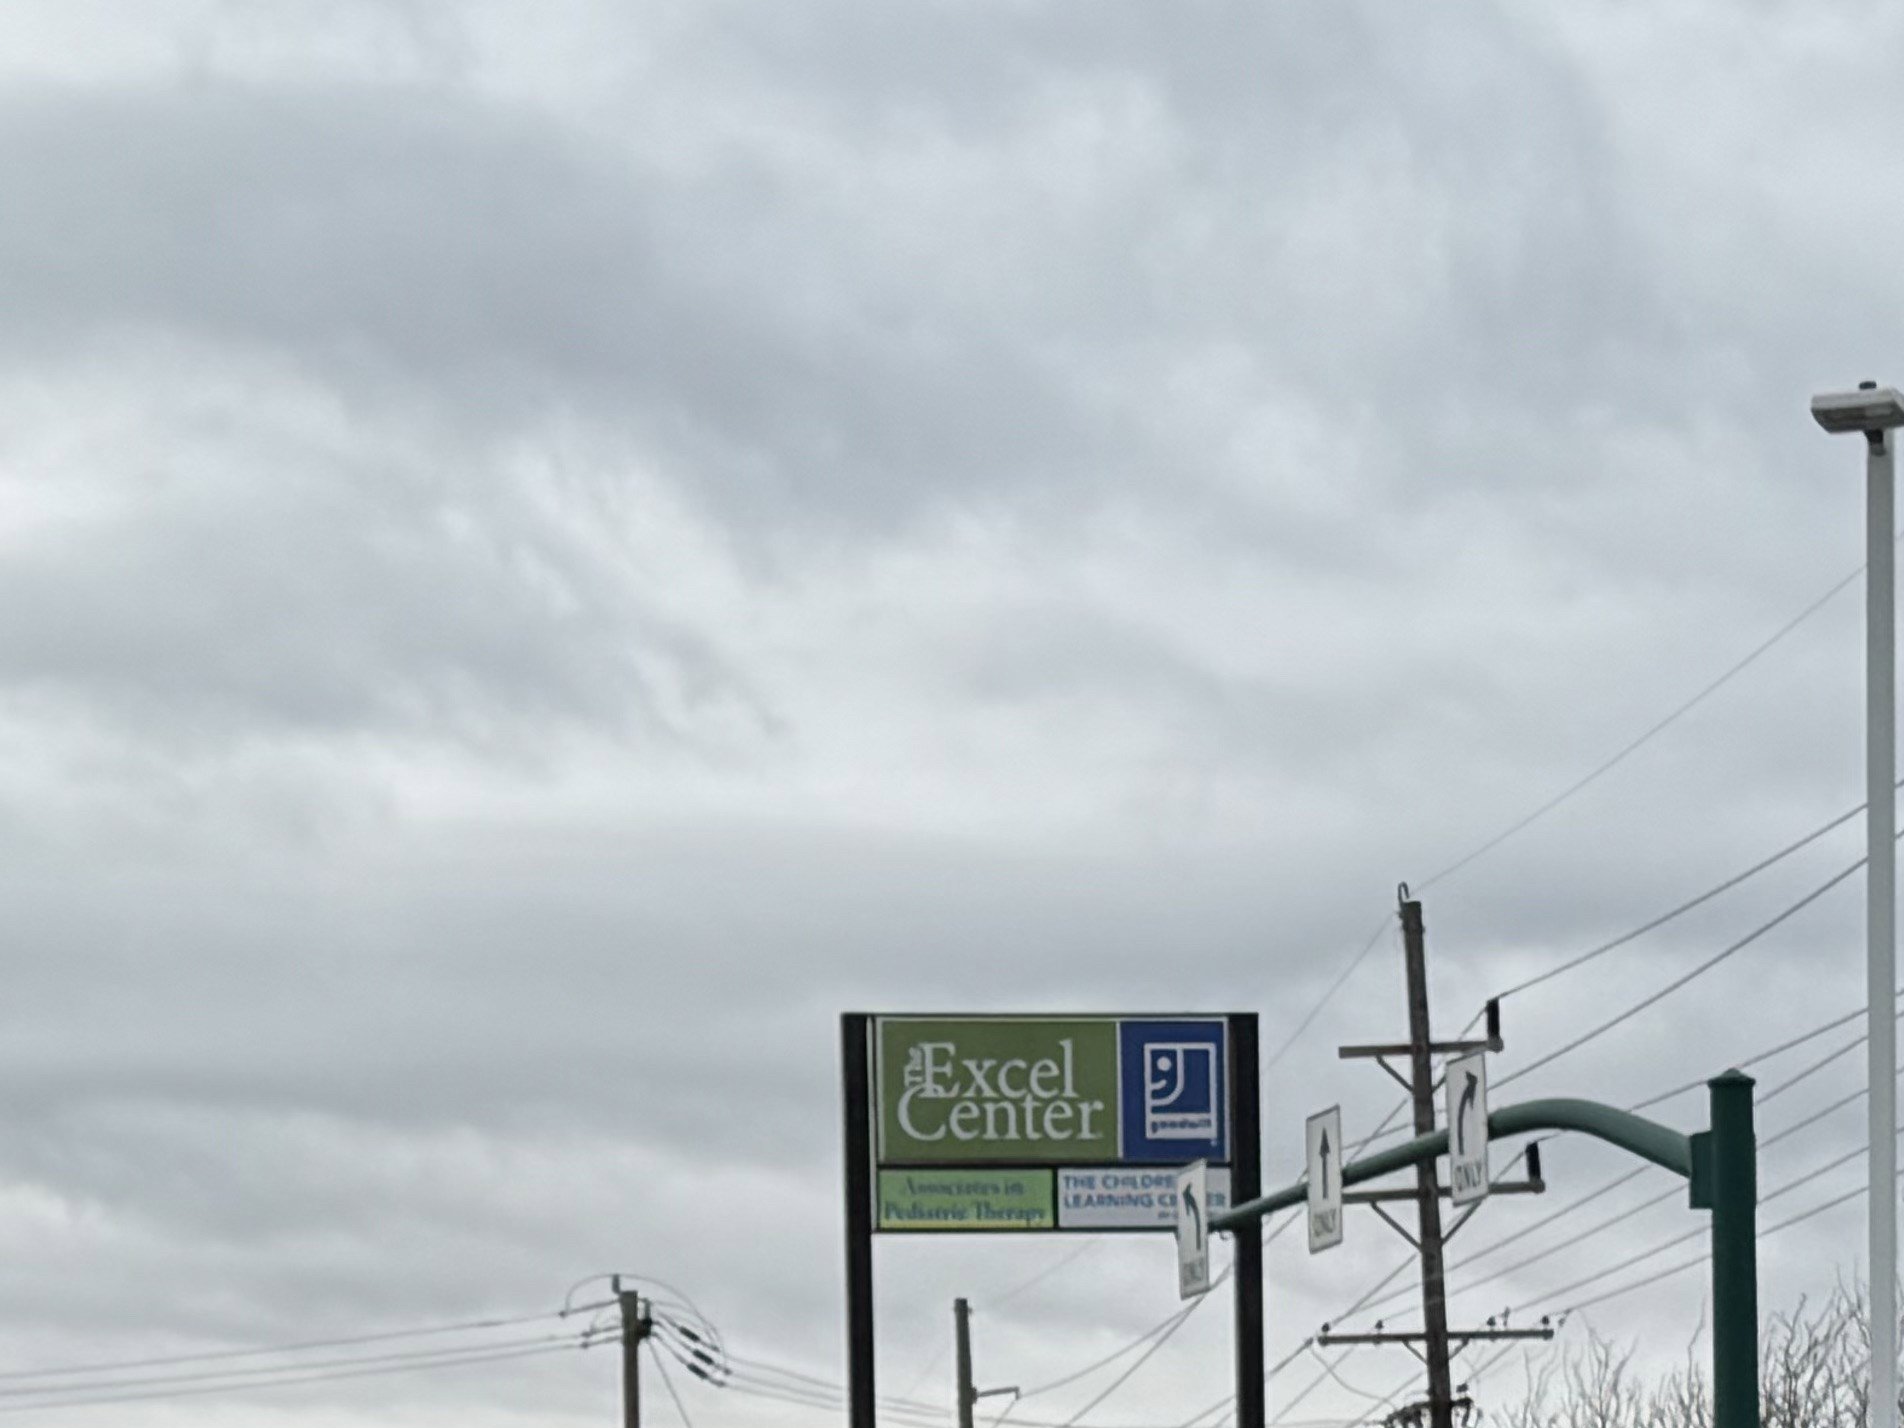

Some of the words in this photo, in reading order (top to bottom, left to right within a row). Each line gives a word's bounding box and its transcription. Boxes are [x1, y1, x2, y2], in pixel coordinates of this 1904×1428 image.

[918, 1038, 1080, 1099] Excel
[897, 1084, 1105, 1141] Center
[1063, 1175, 1096, 1190] THE
[1063, 1193, 1155, 1208] LEARNING
[1156, 1192, 1226, 1207] CEER
